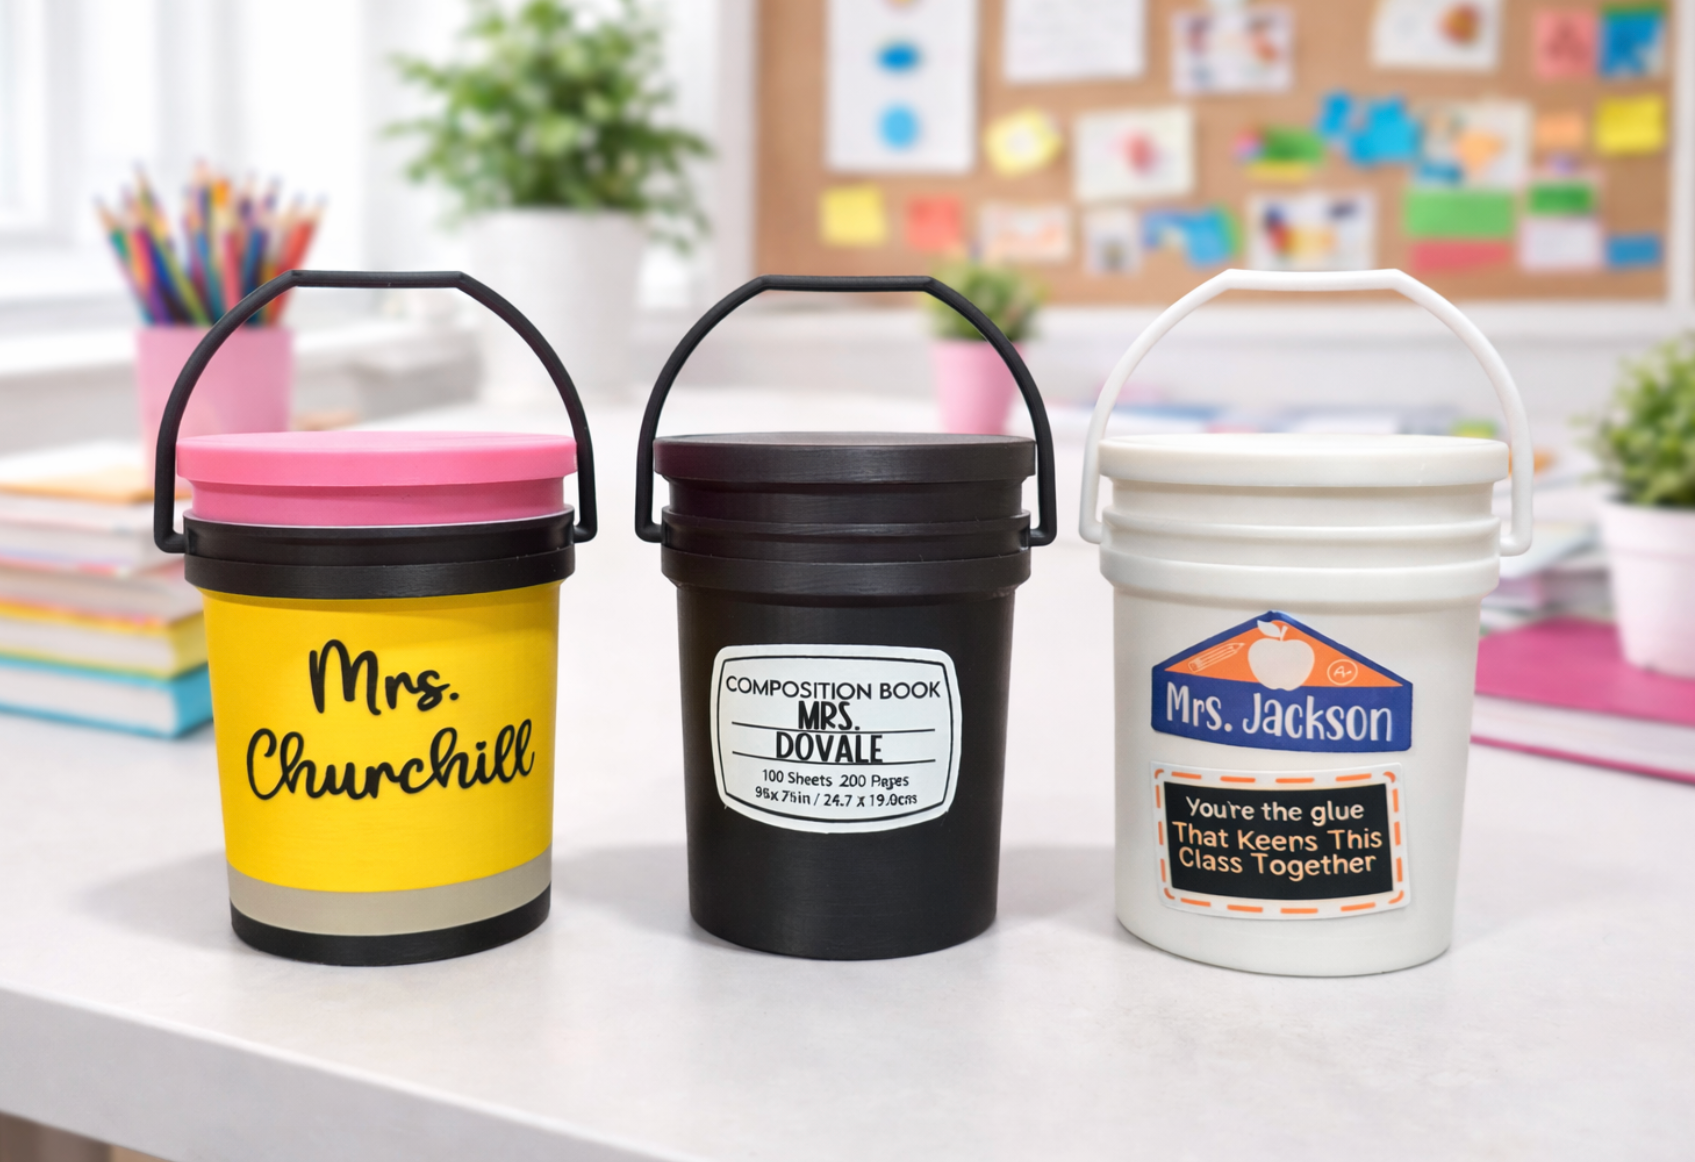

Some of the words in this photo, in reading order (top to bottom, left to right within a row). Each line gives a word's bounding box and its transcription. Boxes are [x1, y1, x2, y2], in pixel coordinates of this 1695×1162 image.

[309, 638, 460, 716] Mrs.
[726, 675, 872, 700] COMPOSITION
[879, 681, 941, 700] BOOK
[798, 700, 860, 731] MRS.
[1166, 681, 1233, 732] Mrs.
[1242, 692, 1392, 742] Jackson
[246, 718, 535, 801] Churchill
[776, 731, 883, 764] DOVALE
[762, 769, 784, 783] 100
[788, 771, 833, 787] Sheets
[838, 774, 867, 787] 200
[1186, 796, 1255, 820] You're
[1261, 801, 1302, 821] the
[1310, 800, 1365, 827] glue
[1172, 821, 1229, 848] That
[1327, 828, 1383, 850] This
[1178, 846, 1243, 874] Class
[1250, 852, 1377, 882] Together
